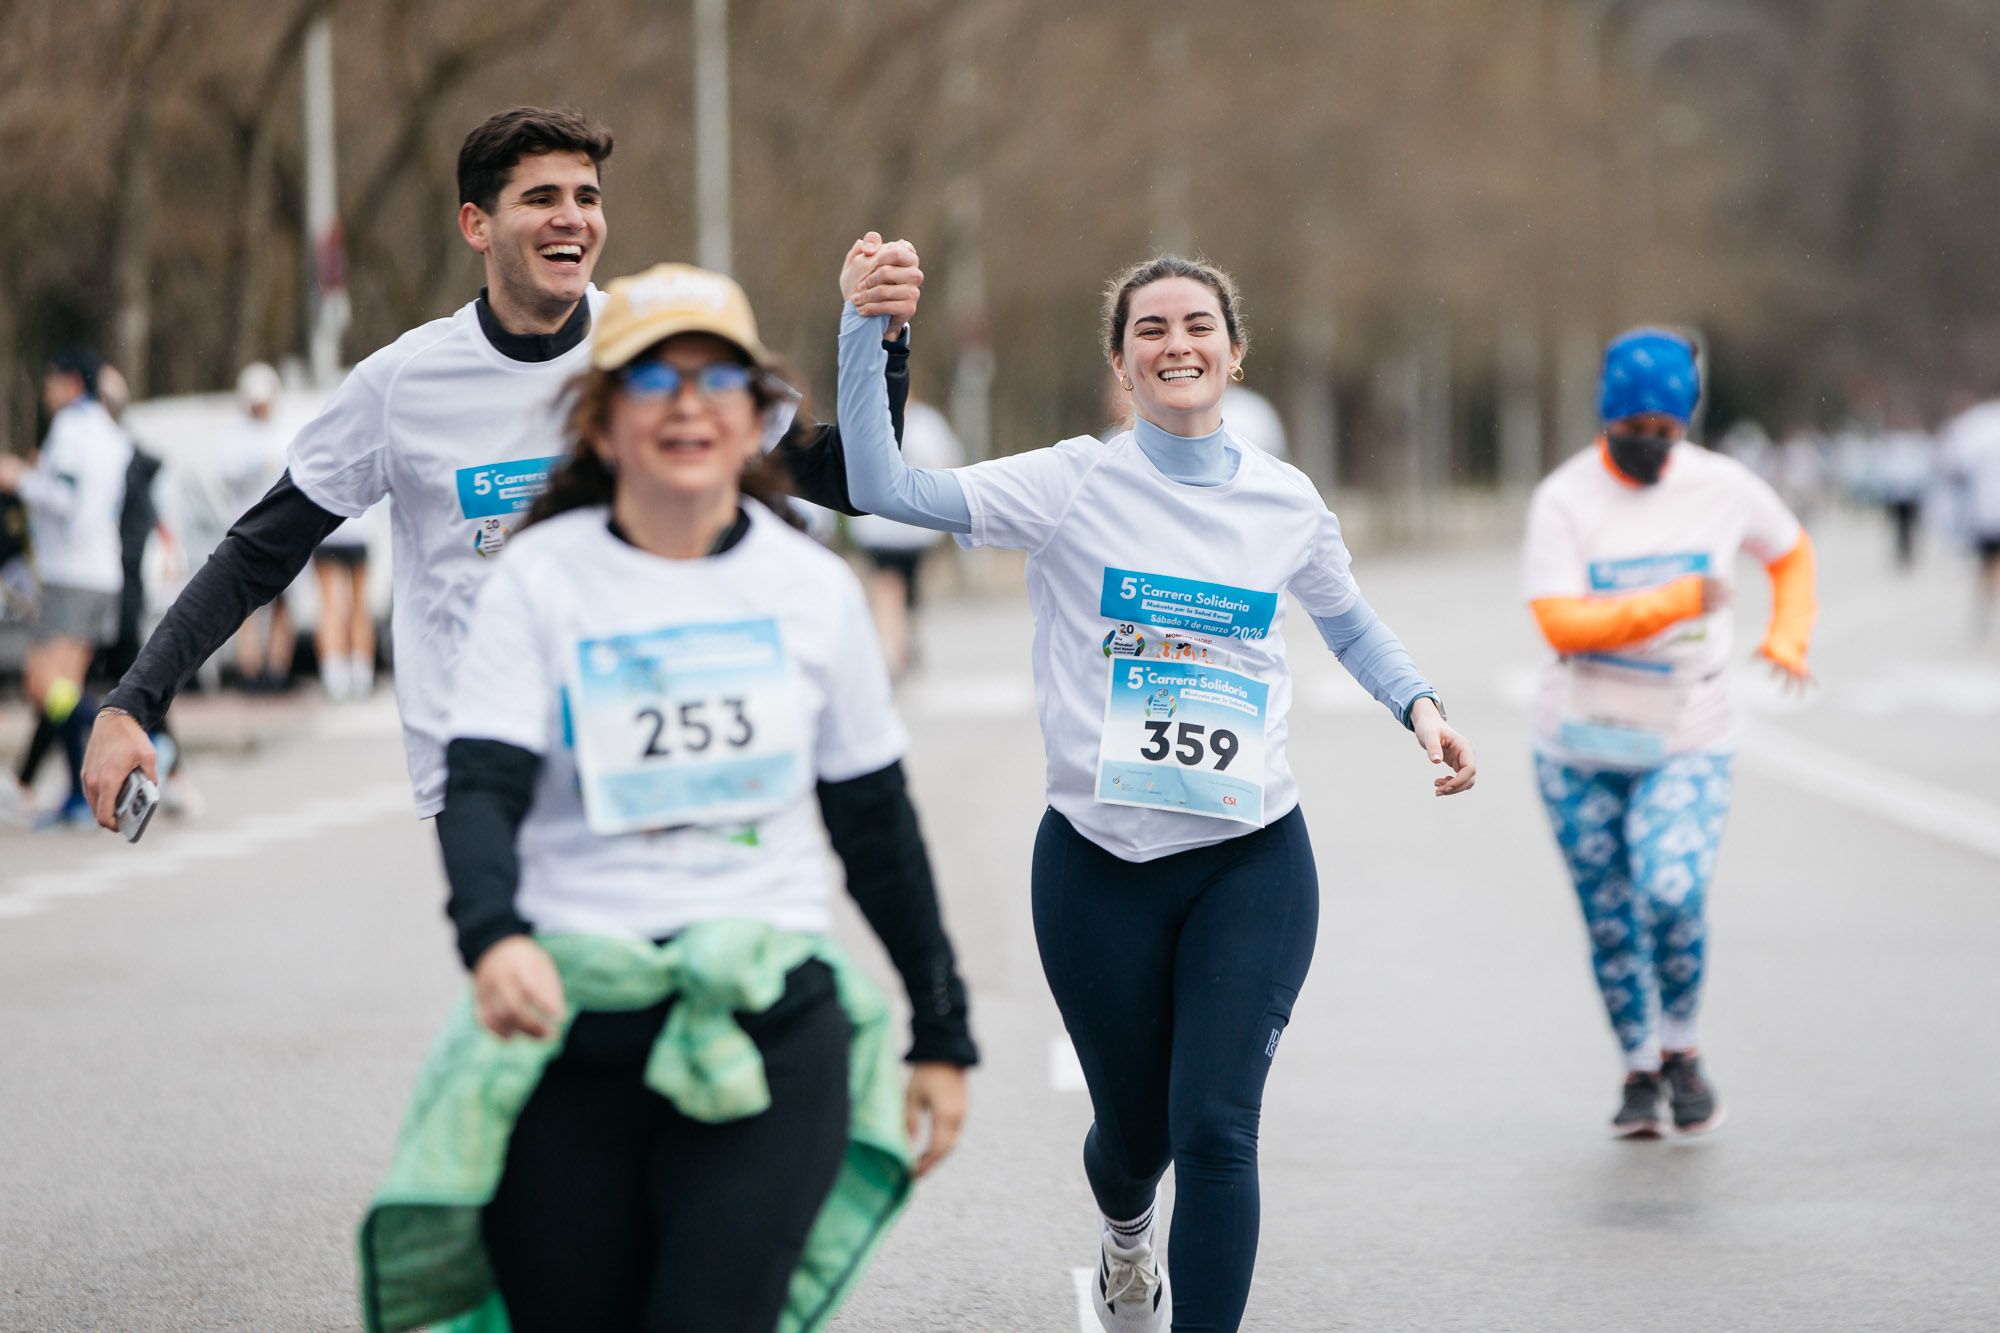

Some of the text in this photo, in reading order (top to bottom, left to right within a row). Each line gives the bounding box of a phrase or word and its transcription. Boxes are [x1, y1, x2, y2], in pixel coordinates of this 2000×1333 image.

[1141, 584, 1192, 602] Carrera
[1195, 592, 1250, 613] Solidaria
[1120, 624, 1134, 634] 20
[1151, 613, 1264, 640] Sábado 7 de marzo 2026
[1147, 672, 1197, 686] Carrera
[1200, 677, 1248, 699] Solidaria
[635, 696, 754, 757] 253
[1140, 720, 1239, 771] 359
